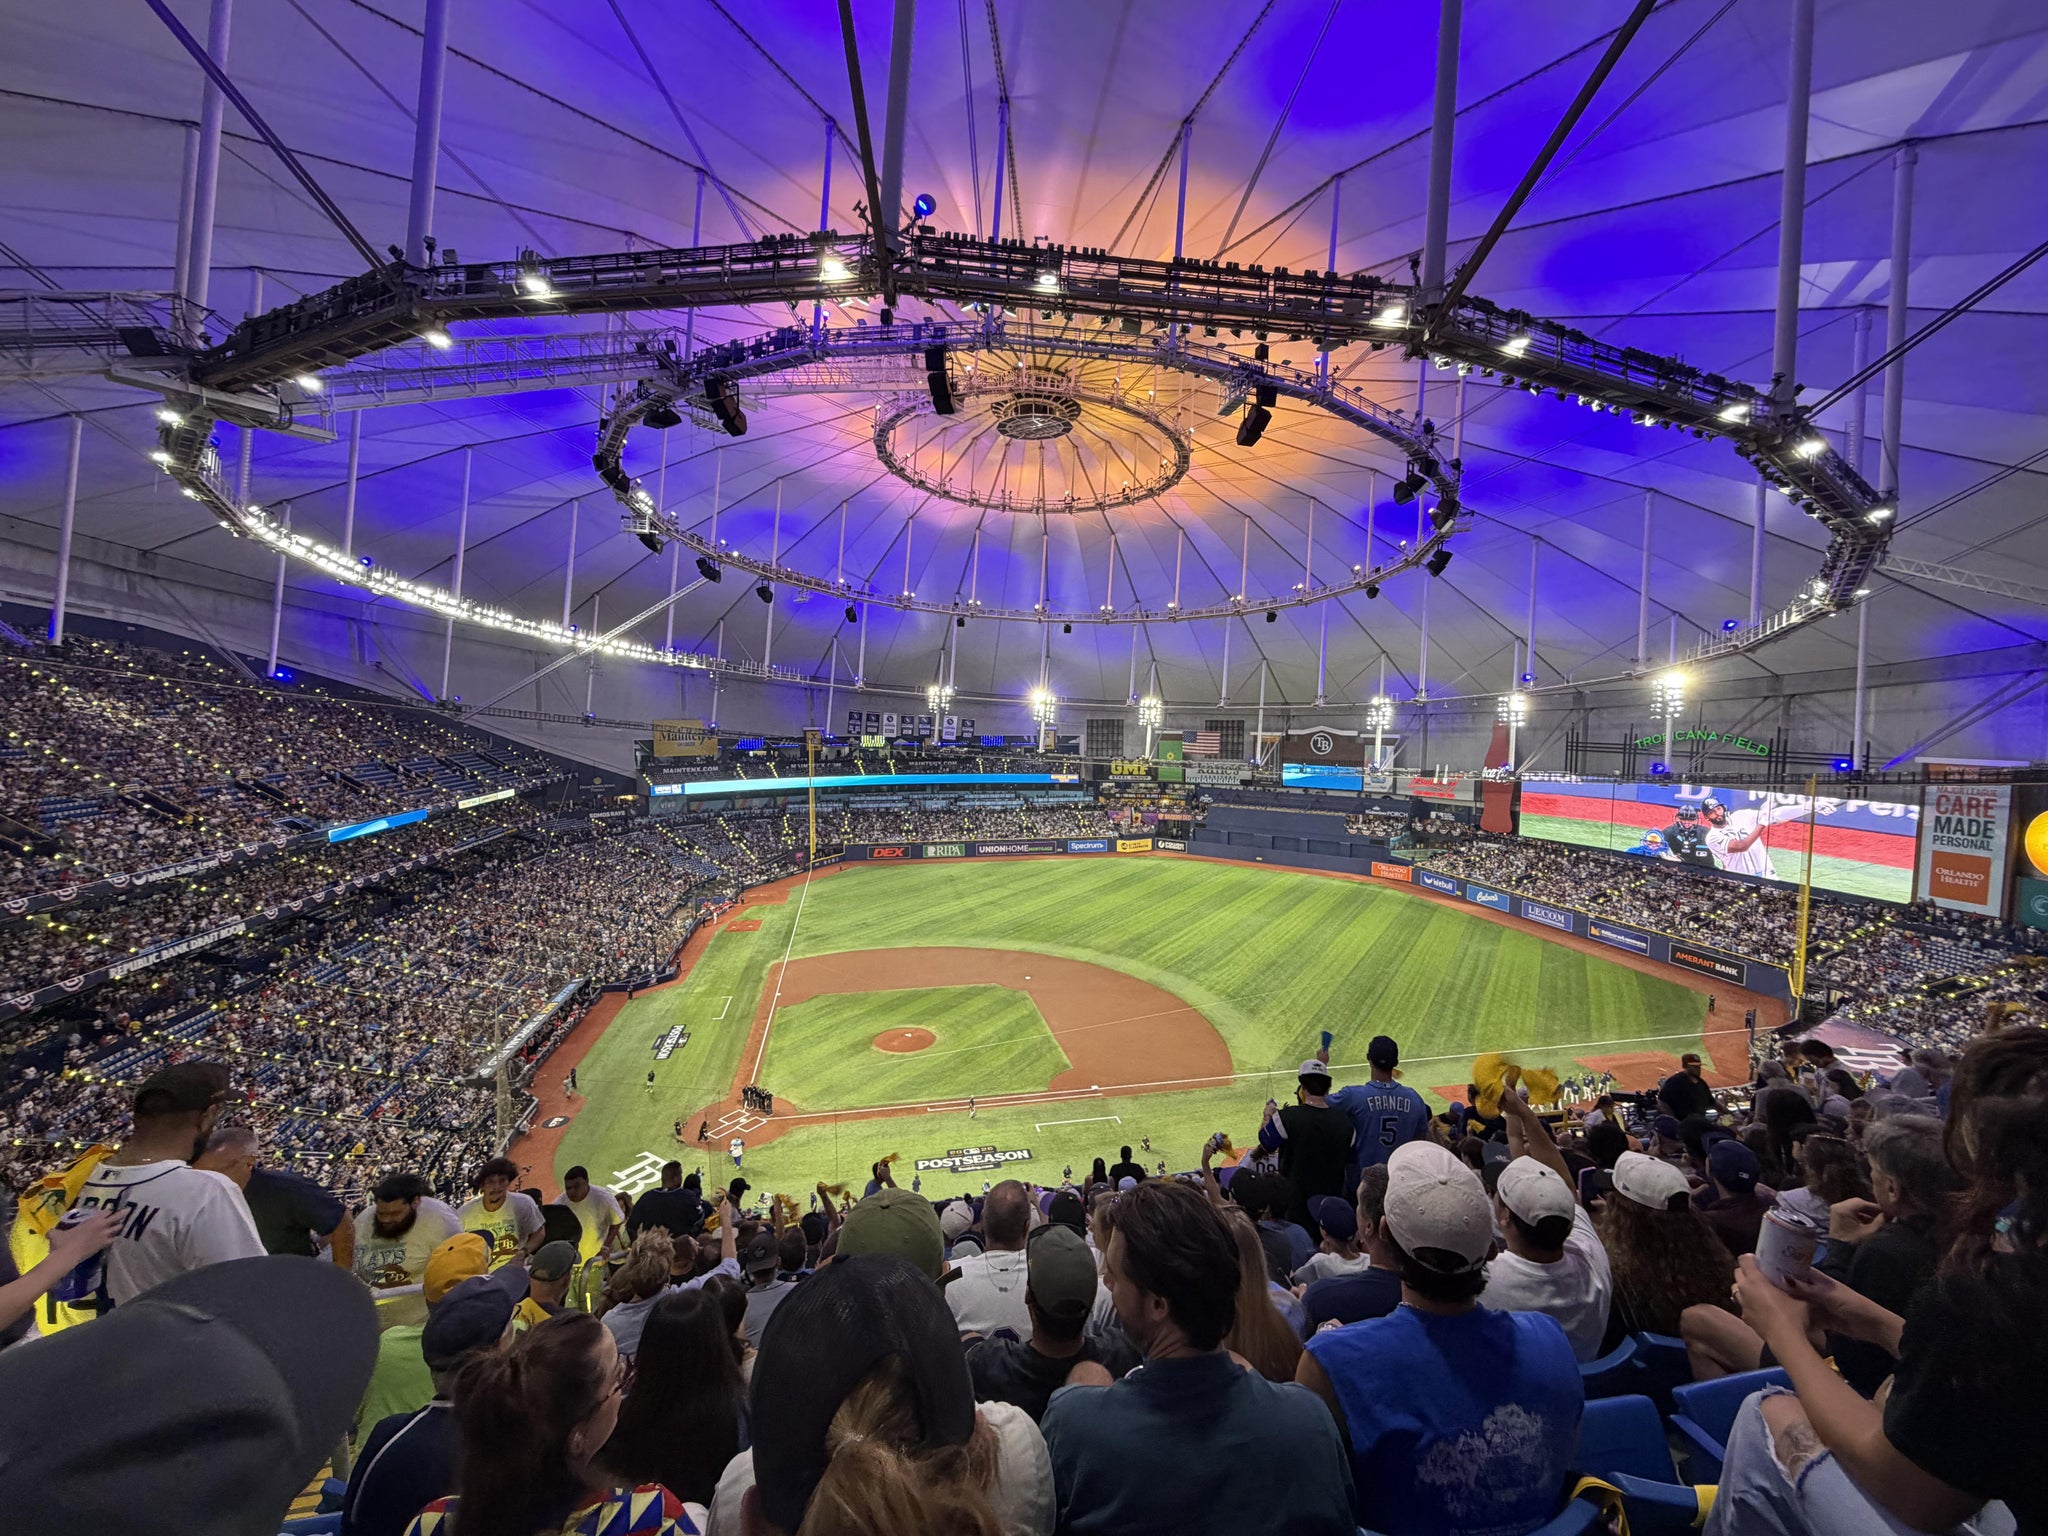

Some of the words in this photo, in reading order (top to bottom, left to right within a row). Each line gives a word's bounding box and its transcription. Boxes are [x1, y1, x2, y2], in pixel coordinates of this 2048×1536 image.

[1314, 737, 1330, 751] TB
[1634, 730, 1718, 749] TROPICANA
[1721, 734, 1769, 757] FIELD
[1936, 786, 1965, 796] MAJOR
[1966, 788, 1998, 797] LEAGUE
[1936, 795, 1998, 819] CARE
[1934, 816, 1996, 839] MADE
[937, 845, 961, 856] RIPA
[1071, 842, 1101, 852] Spectrum
[1932, 835, 1994, 851] PERSONAL
[873, 847, 904, 858] DEX
[1377, 864, 1407, 874] ORLANDO
[1380, 870, 1404, 879] HEALTH
[1936, 867, 1984, 881] ORLANDO
[1432, 878, 1453, 890] Webull
[1940, 875, 1980, 887] HEALTH
[1528, 905, 1565, 923] LECOM
[108, 952, 161, 980] REPUBLIC
[160, 943, 190, 960] BANK
[190, 932, 220, 950] DRAFT
[220, 922, 247, 940] ROOM
[1676, 951, 1716, 968] AMERANT
[1715, 964, 1739, 977] BANK
[1366, 1096, 1411, 1113] FRANCO
[1379, 1116, 1399, 1147] 5
[917, 1149, 1030, 1170] POSTSEASON
[606, 1151, 669, 1195] TB
